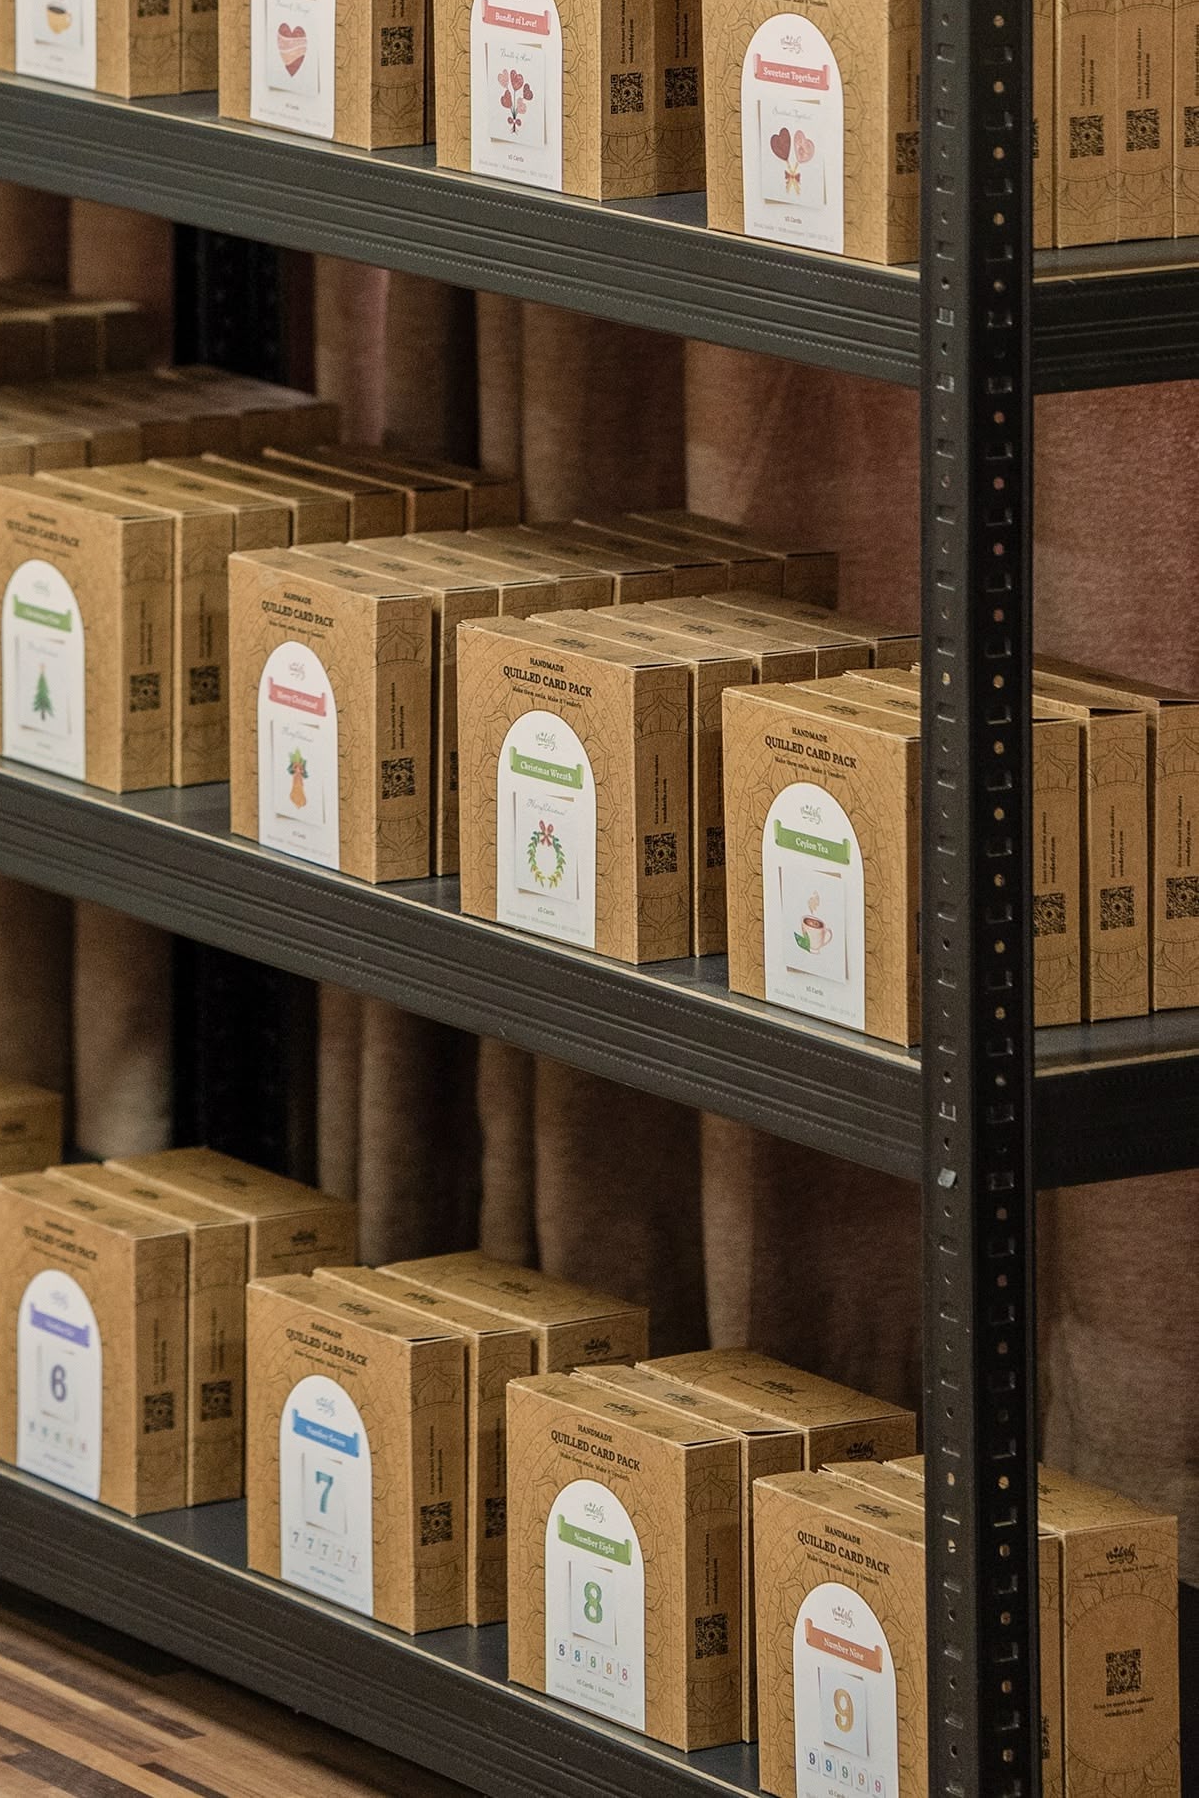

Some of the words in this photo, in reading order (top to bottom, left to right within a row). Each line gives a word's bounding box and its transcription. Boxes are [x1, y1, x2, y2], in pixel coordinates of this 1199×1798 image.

[495, 12, 515, 23] Bundle
[521, 17, 537, 28] Love!
[763, 67, 790, 80] Sweetest
[791, 71, 820, 84] Together!
[262, 600, 292, 617] QUILLED
[294, 609, 314, 623] CARD
[315, 614, 334, 628] PACK
[529, 657, 564, 673] HANDMADE
[503, 665, 541, 685] QUILLED
[543, 676, 567, 691] CARD
[569, 682, 592, 698] PACK
[792, 727, 828, 743] HANDMADE
[765, 735, 804, 755] QUILLED
[806, 746, 831, 762] CARD
[832, 753, 857, 769] PACK
[520, 760, 549, 777] Christmas
[550, 768, 573, 783] Wreath
[795, 837, 817, 851] Ceylon
[817, 843, 829, 854] Tea
[51, 1364, 68, 1403] 6
[577, 1424, 613, 1443] HANDMADE
[551, 1430, 589, 1452] QUILLED
[590, 1444, 615, 1462] CARD
[617, 1453, 641, 1472] PACK
[315, 1470, 334, 1514] 7
[307, 1537, 314, 1550] 7
[574, 1531, 598, 1548] Number
[598, 1540, 615, 1555] Eight
[824, 1524, 861, 1545] HANDMADE
[797, 1530, 837, 1554] QUILLED
[838, 1546, 864, 1565] CARD
[865, 1555, 891, 1576] PACK
[583, 1581, 603, 1624] 8
[558, 1643, 565, 1656] 8
[574, 1649, 581, 1663] 8
[590, 1655, 596, 1668] 8
[606, 1662, 612, 1675] 8
[621, 1668, 628, 1681] 8
[823, 1637, 849, 1655] Number
[849, 1647, 864, 1661] Nine
[833, 1688, 854, 1733] 9
[809, 1752, 815, 1765] 9
[825, 1759, 832, 1772] 9
[842, 1766, 848, 1779] 9
[875, 1779, 881, 1793] 9
